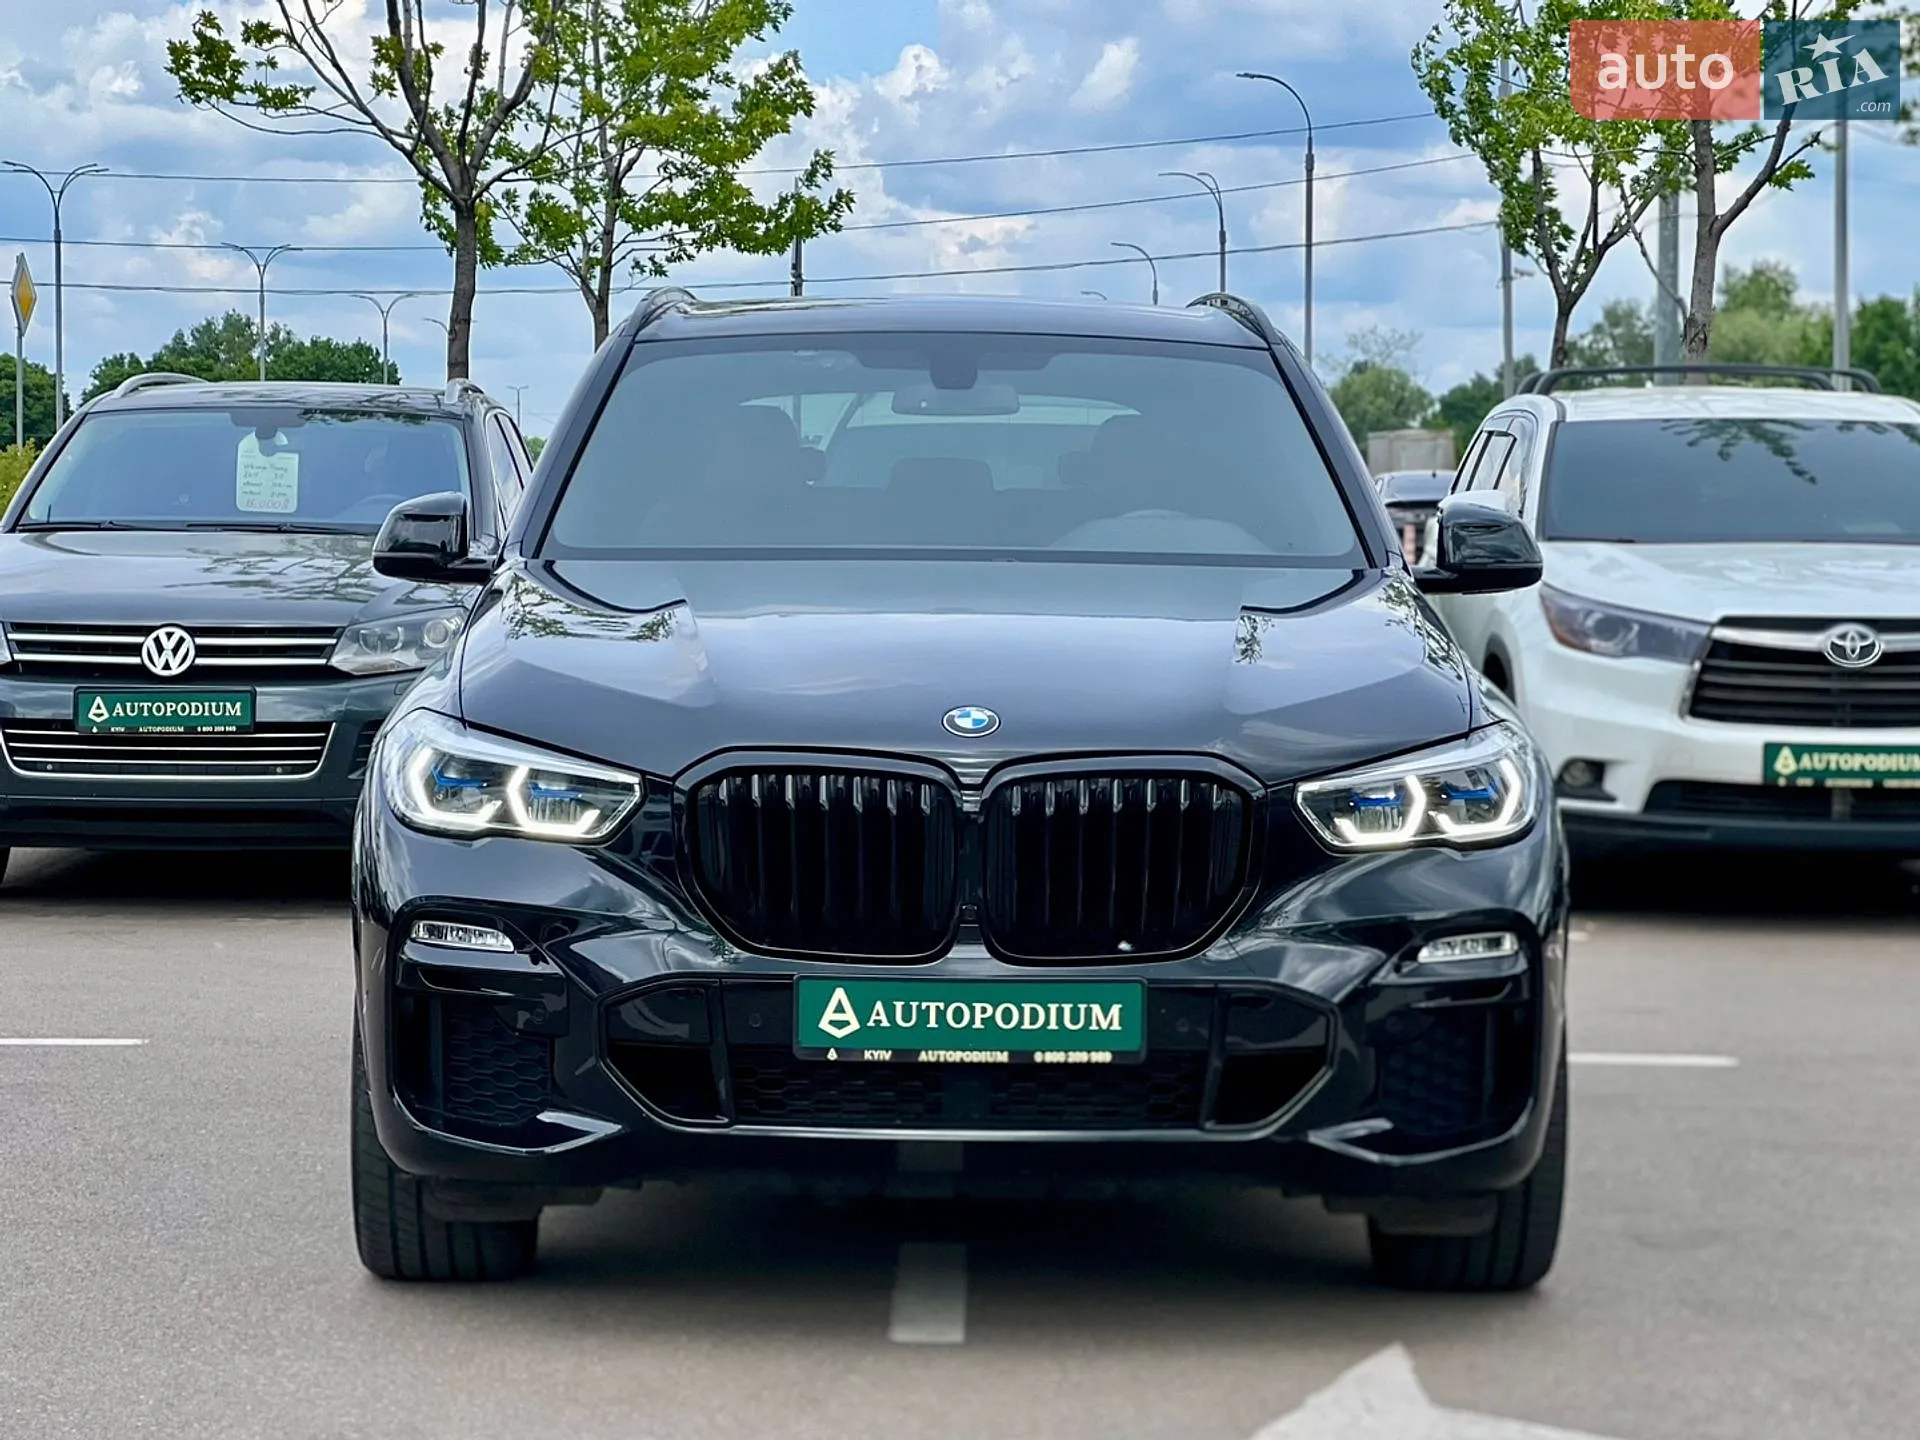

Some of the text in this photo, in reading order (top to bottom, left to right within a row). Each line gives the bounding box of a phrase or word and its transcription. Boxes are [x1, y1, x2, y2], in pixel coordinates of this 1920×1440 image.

[144, 628, 193, 674] VW
[112, 702, 242, 716] AUTOPODIUM
[138, 725, 185, 733] AUTOPODIUM
[866, 1000, 1123, 1031] AUTOPODIUM
[863, 1049, 892, 1061] KYIV
[917, 1050, 1009, 1063] AUTOPODIUM
